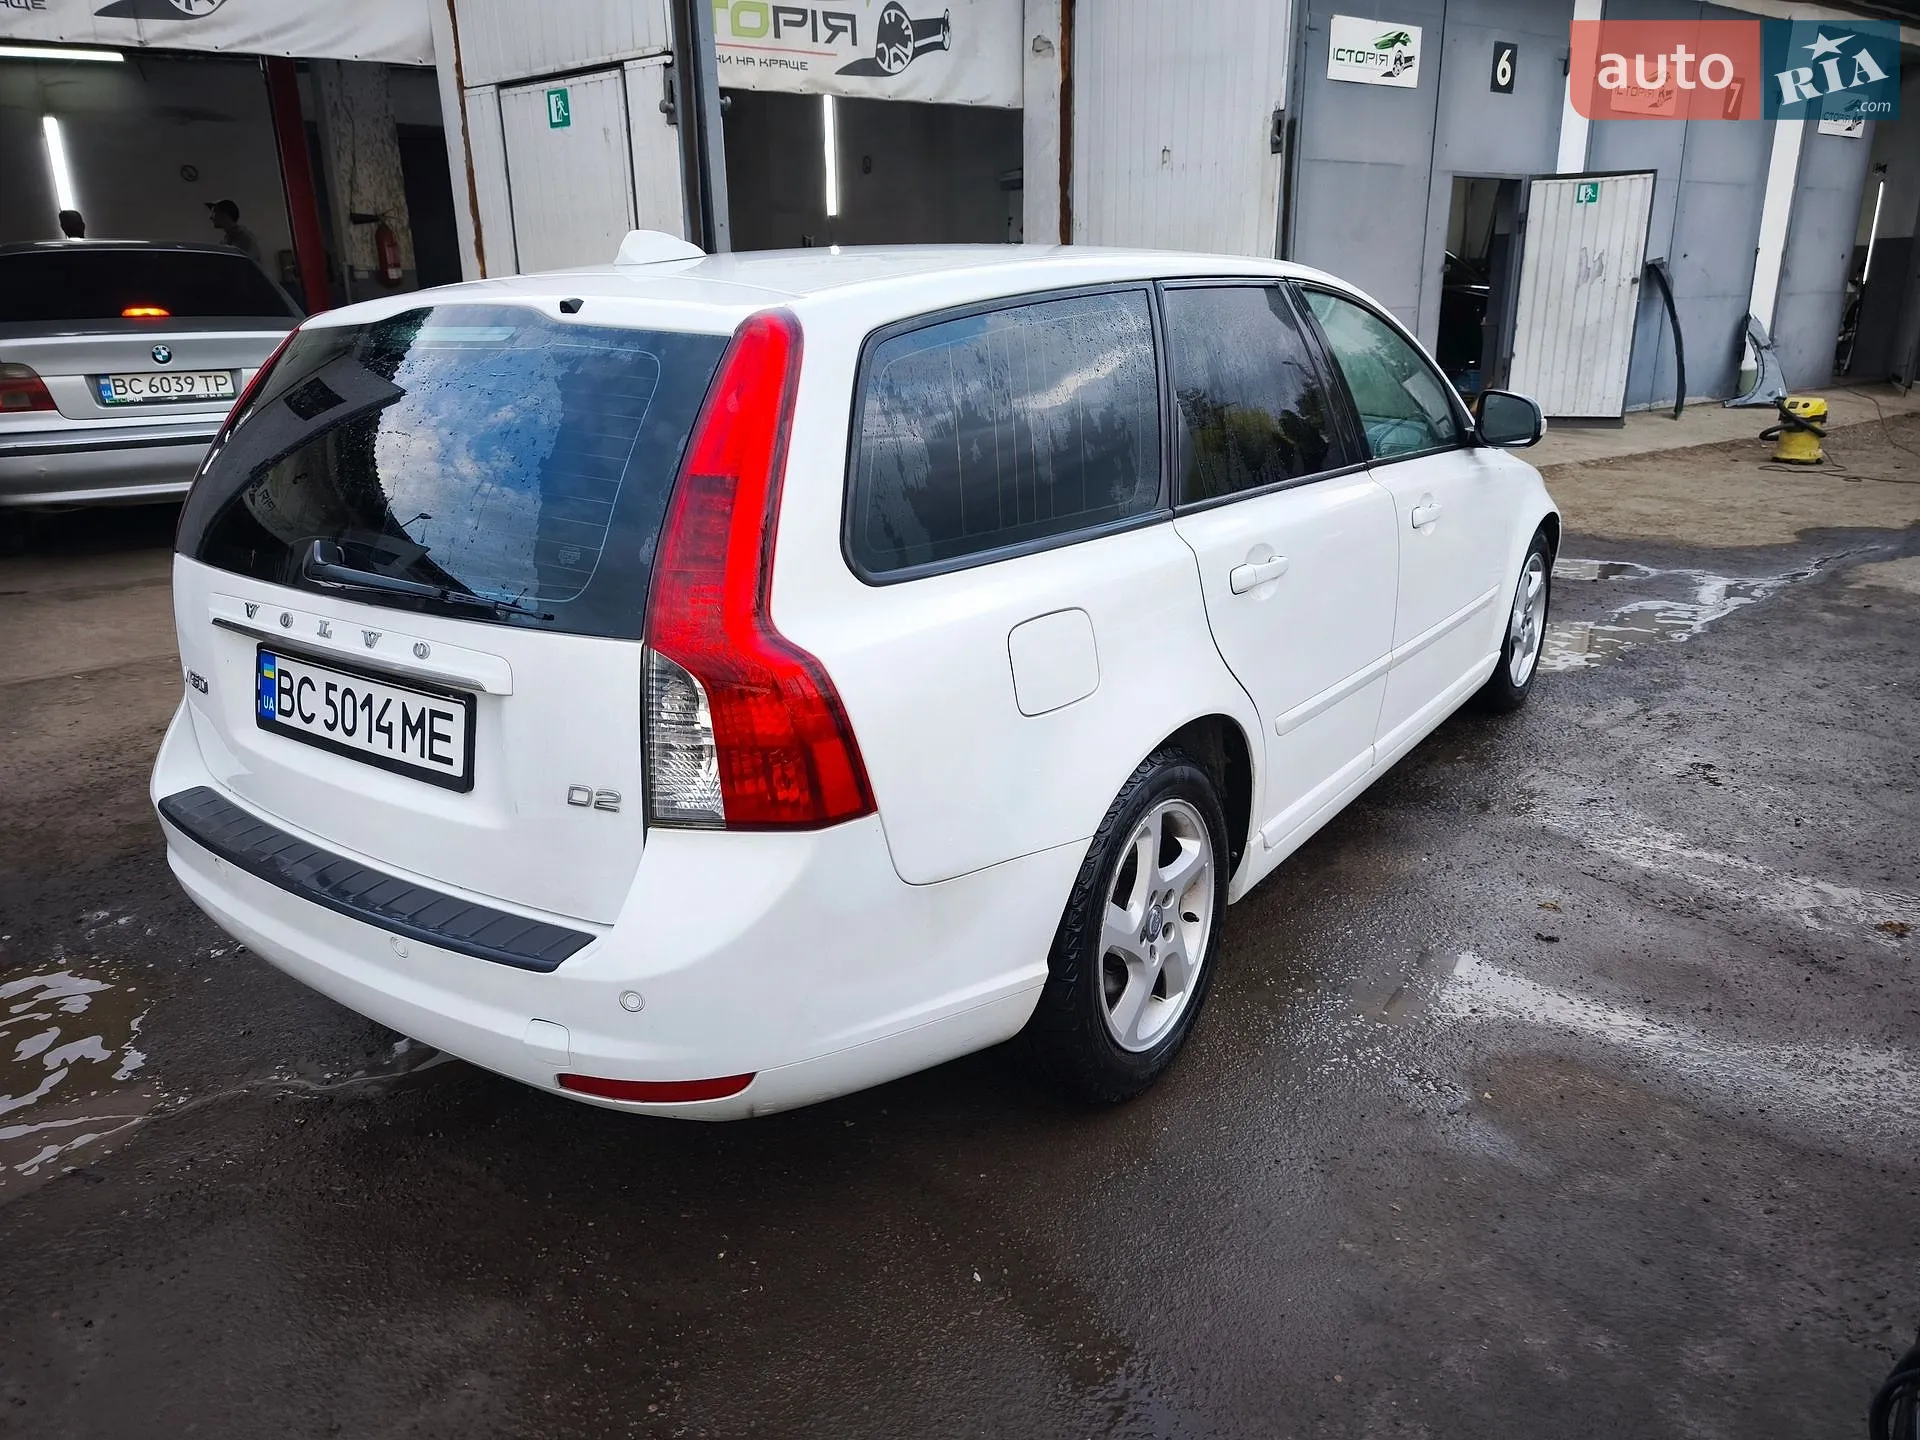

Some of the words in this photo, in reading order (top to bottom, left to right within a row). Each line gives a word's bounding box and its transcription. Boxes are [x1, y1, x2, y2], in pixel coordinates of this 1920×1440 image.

[736, 57, 755, 67] НА
[759, 58, 809, 71] КРАЩЕ
[1333, 48, 1389, 67] ІСТОРІЯ
[1496, 49, 1511, 86] 6
[112, 378, 144, 396] BC
[148, 376, 195, 394] 6039
[198, 375, 228, 392] TP
[245, 602, 431, 660] VOLVO
[263, 695, 275, 711] UA
[277, 668, 317, 724] BC
[323, 681, 393, 750] 5014
[402, 701, 455, 766] ME
[567, 784, 622, 813] D2
